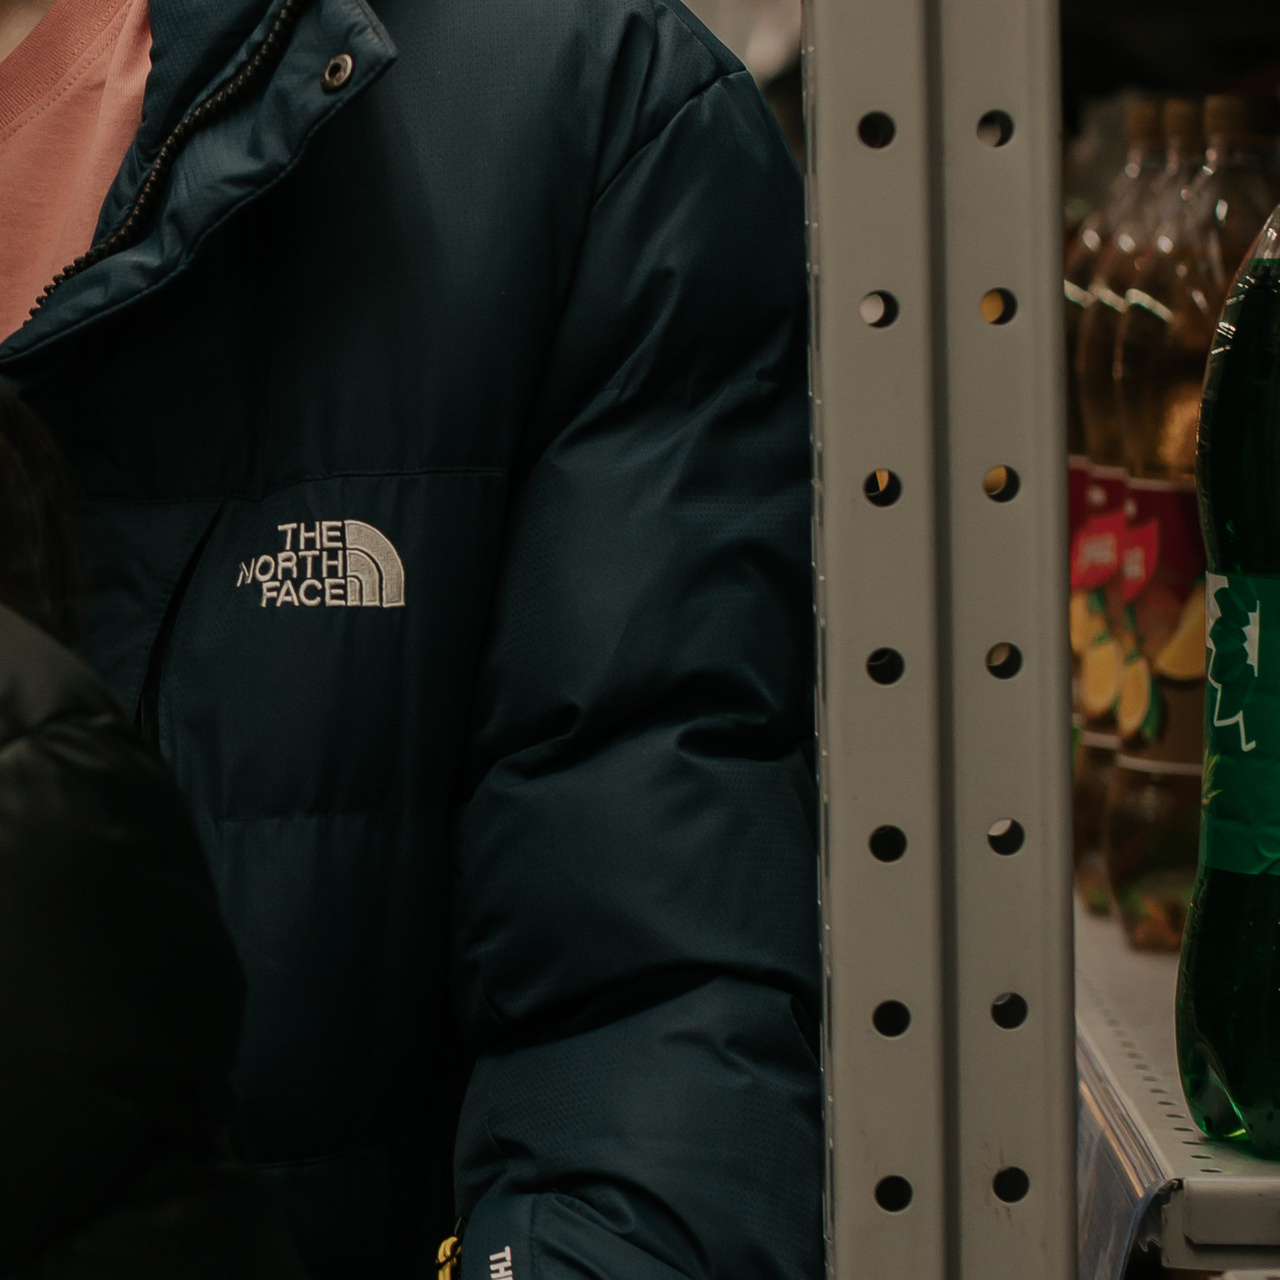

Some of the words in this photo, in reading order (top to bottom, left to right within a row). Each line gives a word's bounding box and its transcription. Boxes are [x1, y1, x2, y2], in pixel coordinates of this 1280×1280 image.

[278, 521, 343, 550] THE
[236, 551, 344, 587] NORTH
[261, 578, 346, 608] FACE
